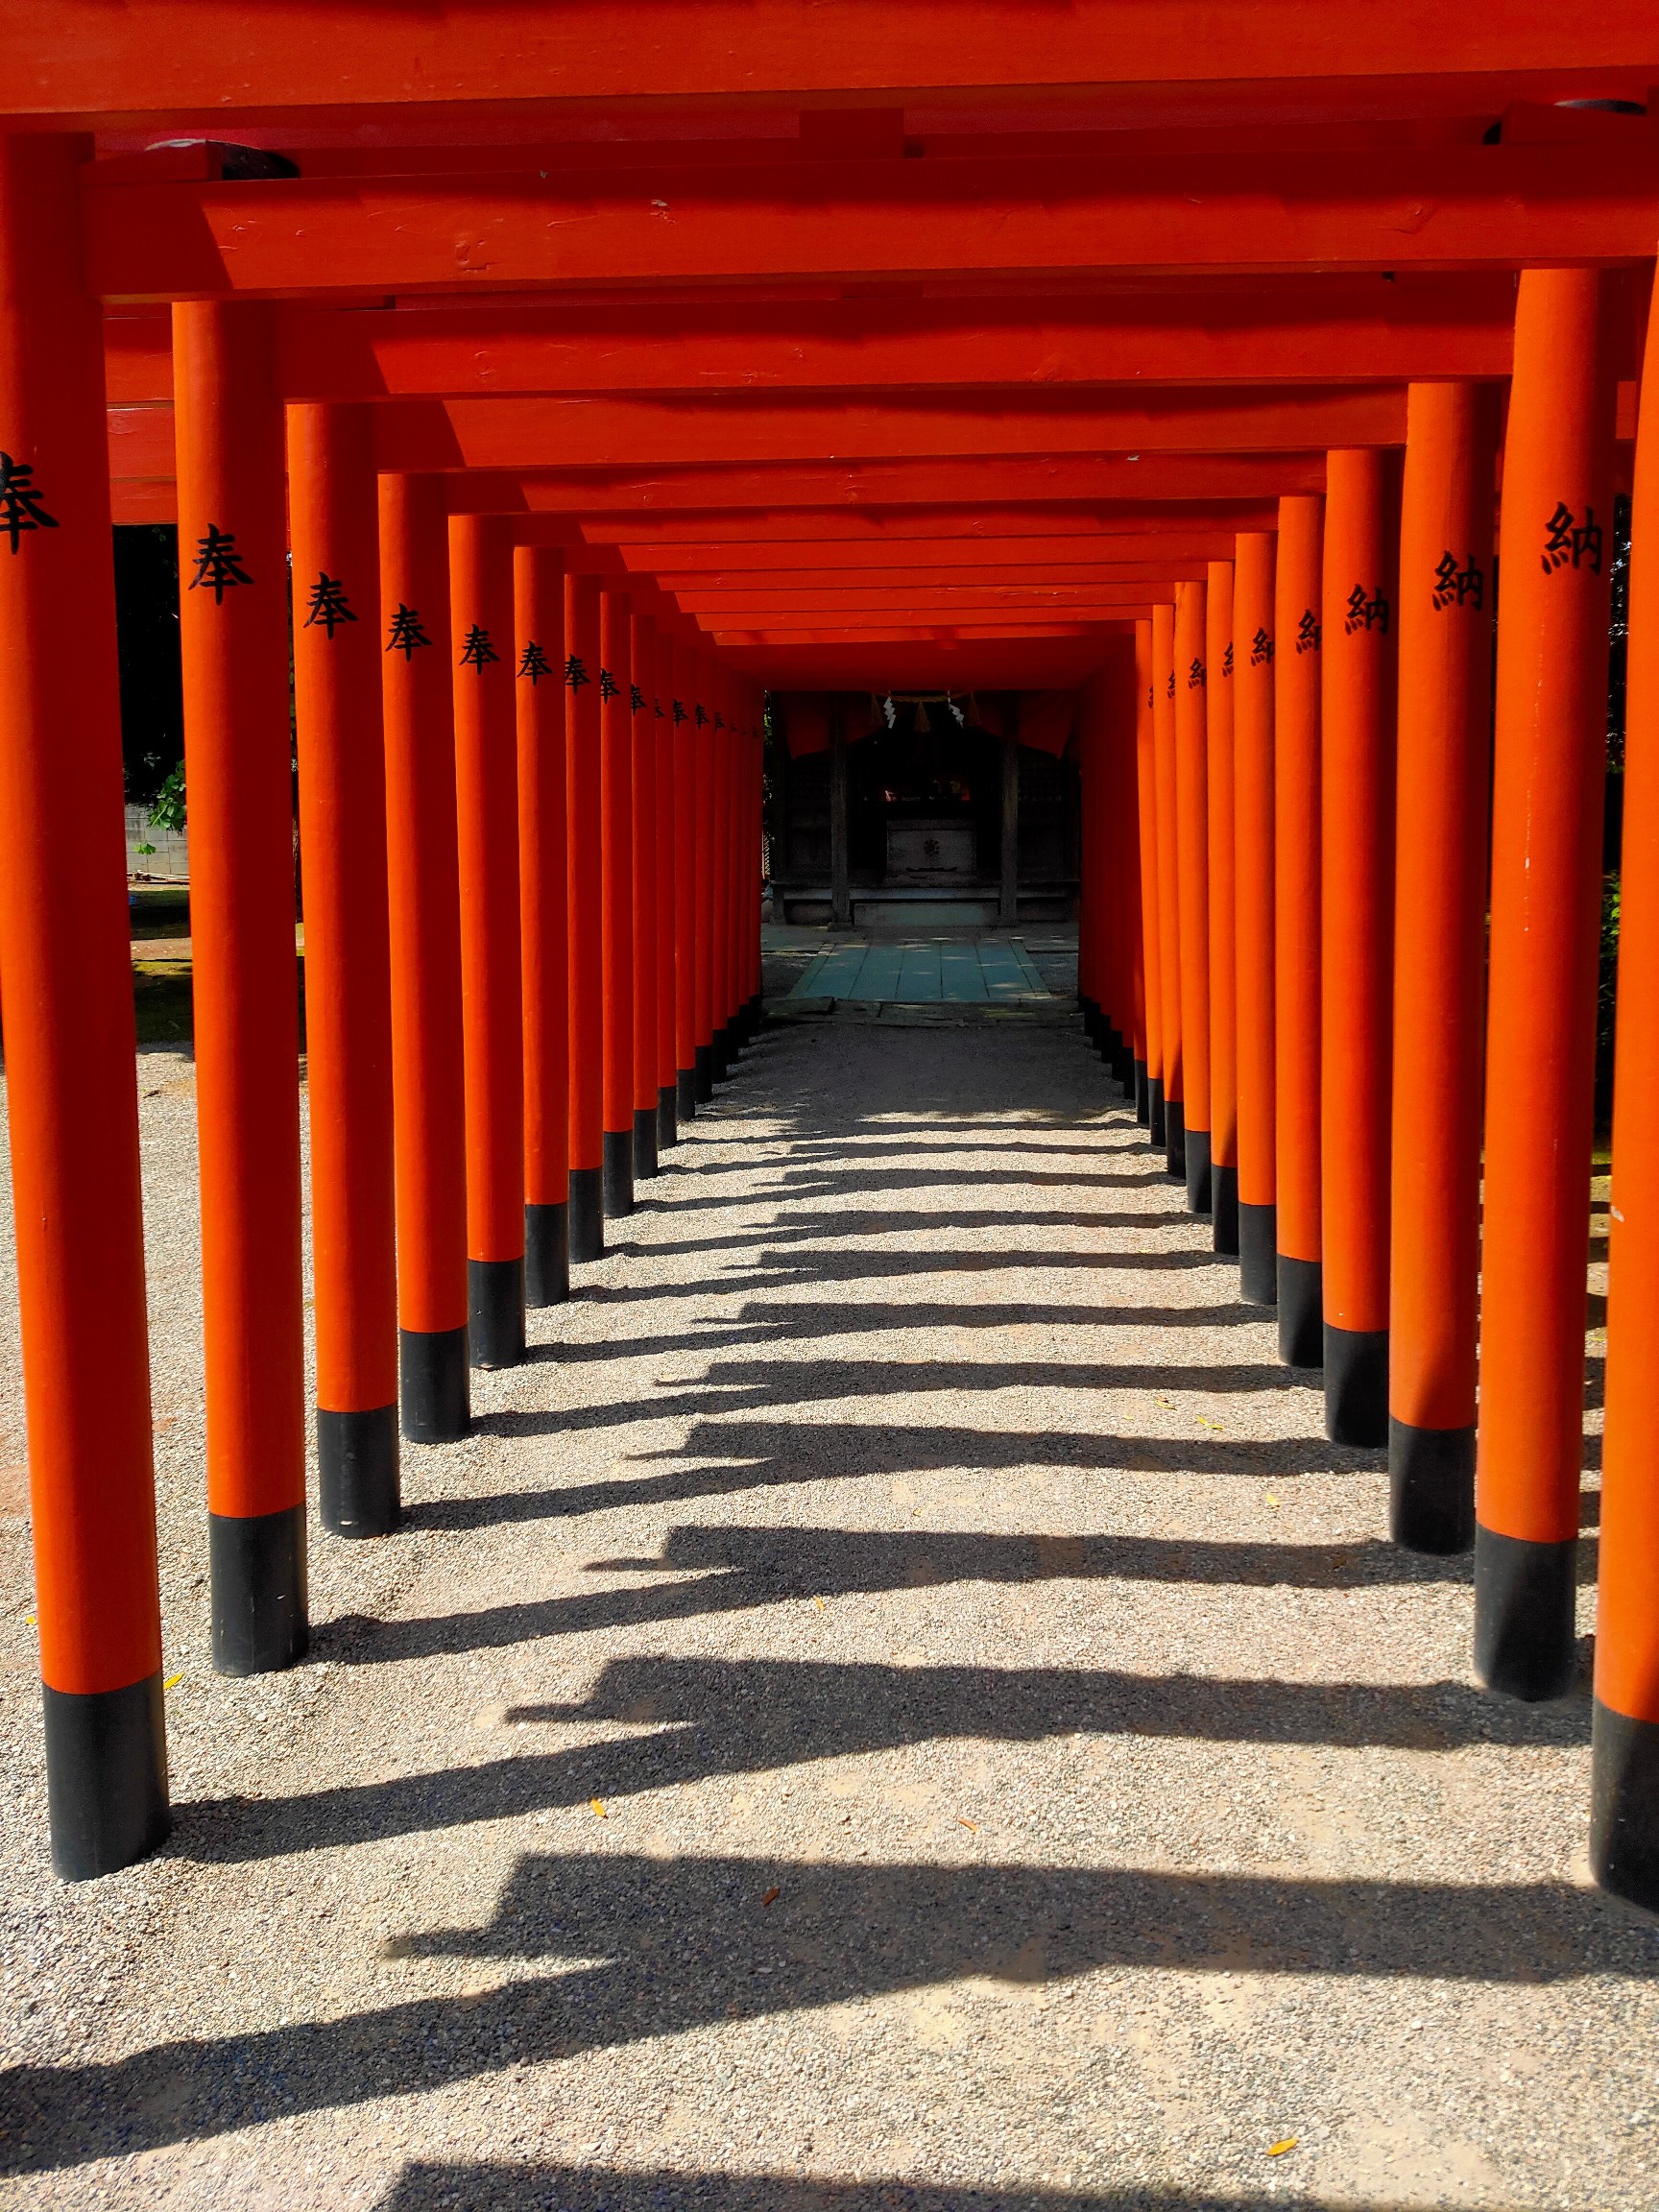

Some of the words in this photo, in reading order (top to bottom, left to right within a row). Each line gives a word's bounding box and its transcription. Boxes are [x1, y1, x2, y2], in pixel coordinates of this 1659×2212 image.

[187, 523, 254, 606] 奉
[1540, 501, 1602, 575] 納
[303, 571, 358, 639] 奉
[1345, 583, 1390, 636] 納
[1432, 550, 1484, 612] 納
[385, 603, 432, 661] 奉
[459, 623, 500, 675] 奉
[516, 640, 553, 686] 奉
[565, 654, 591, 694] 奉
